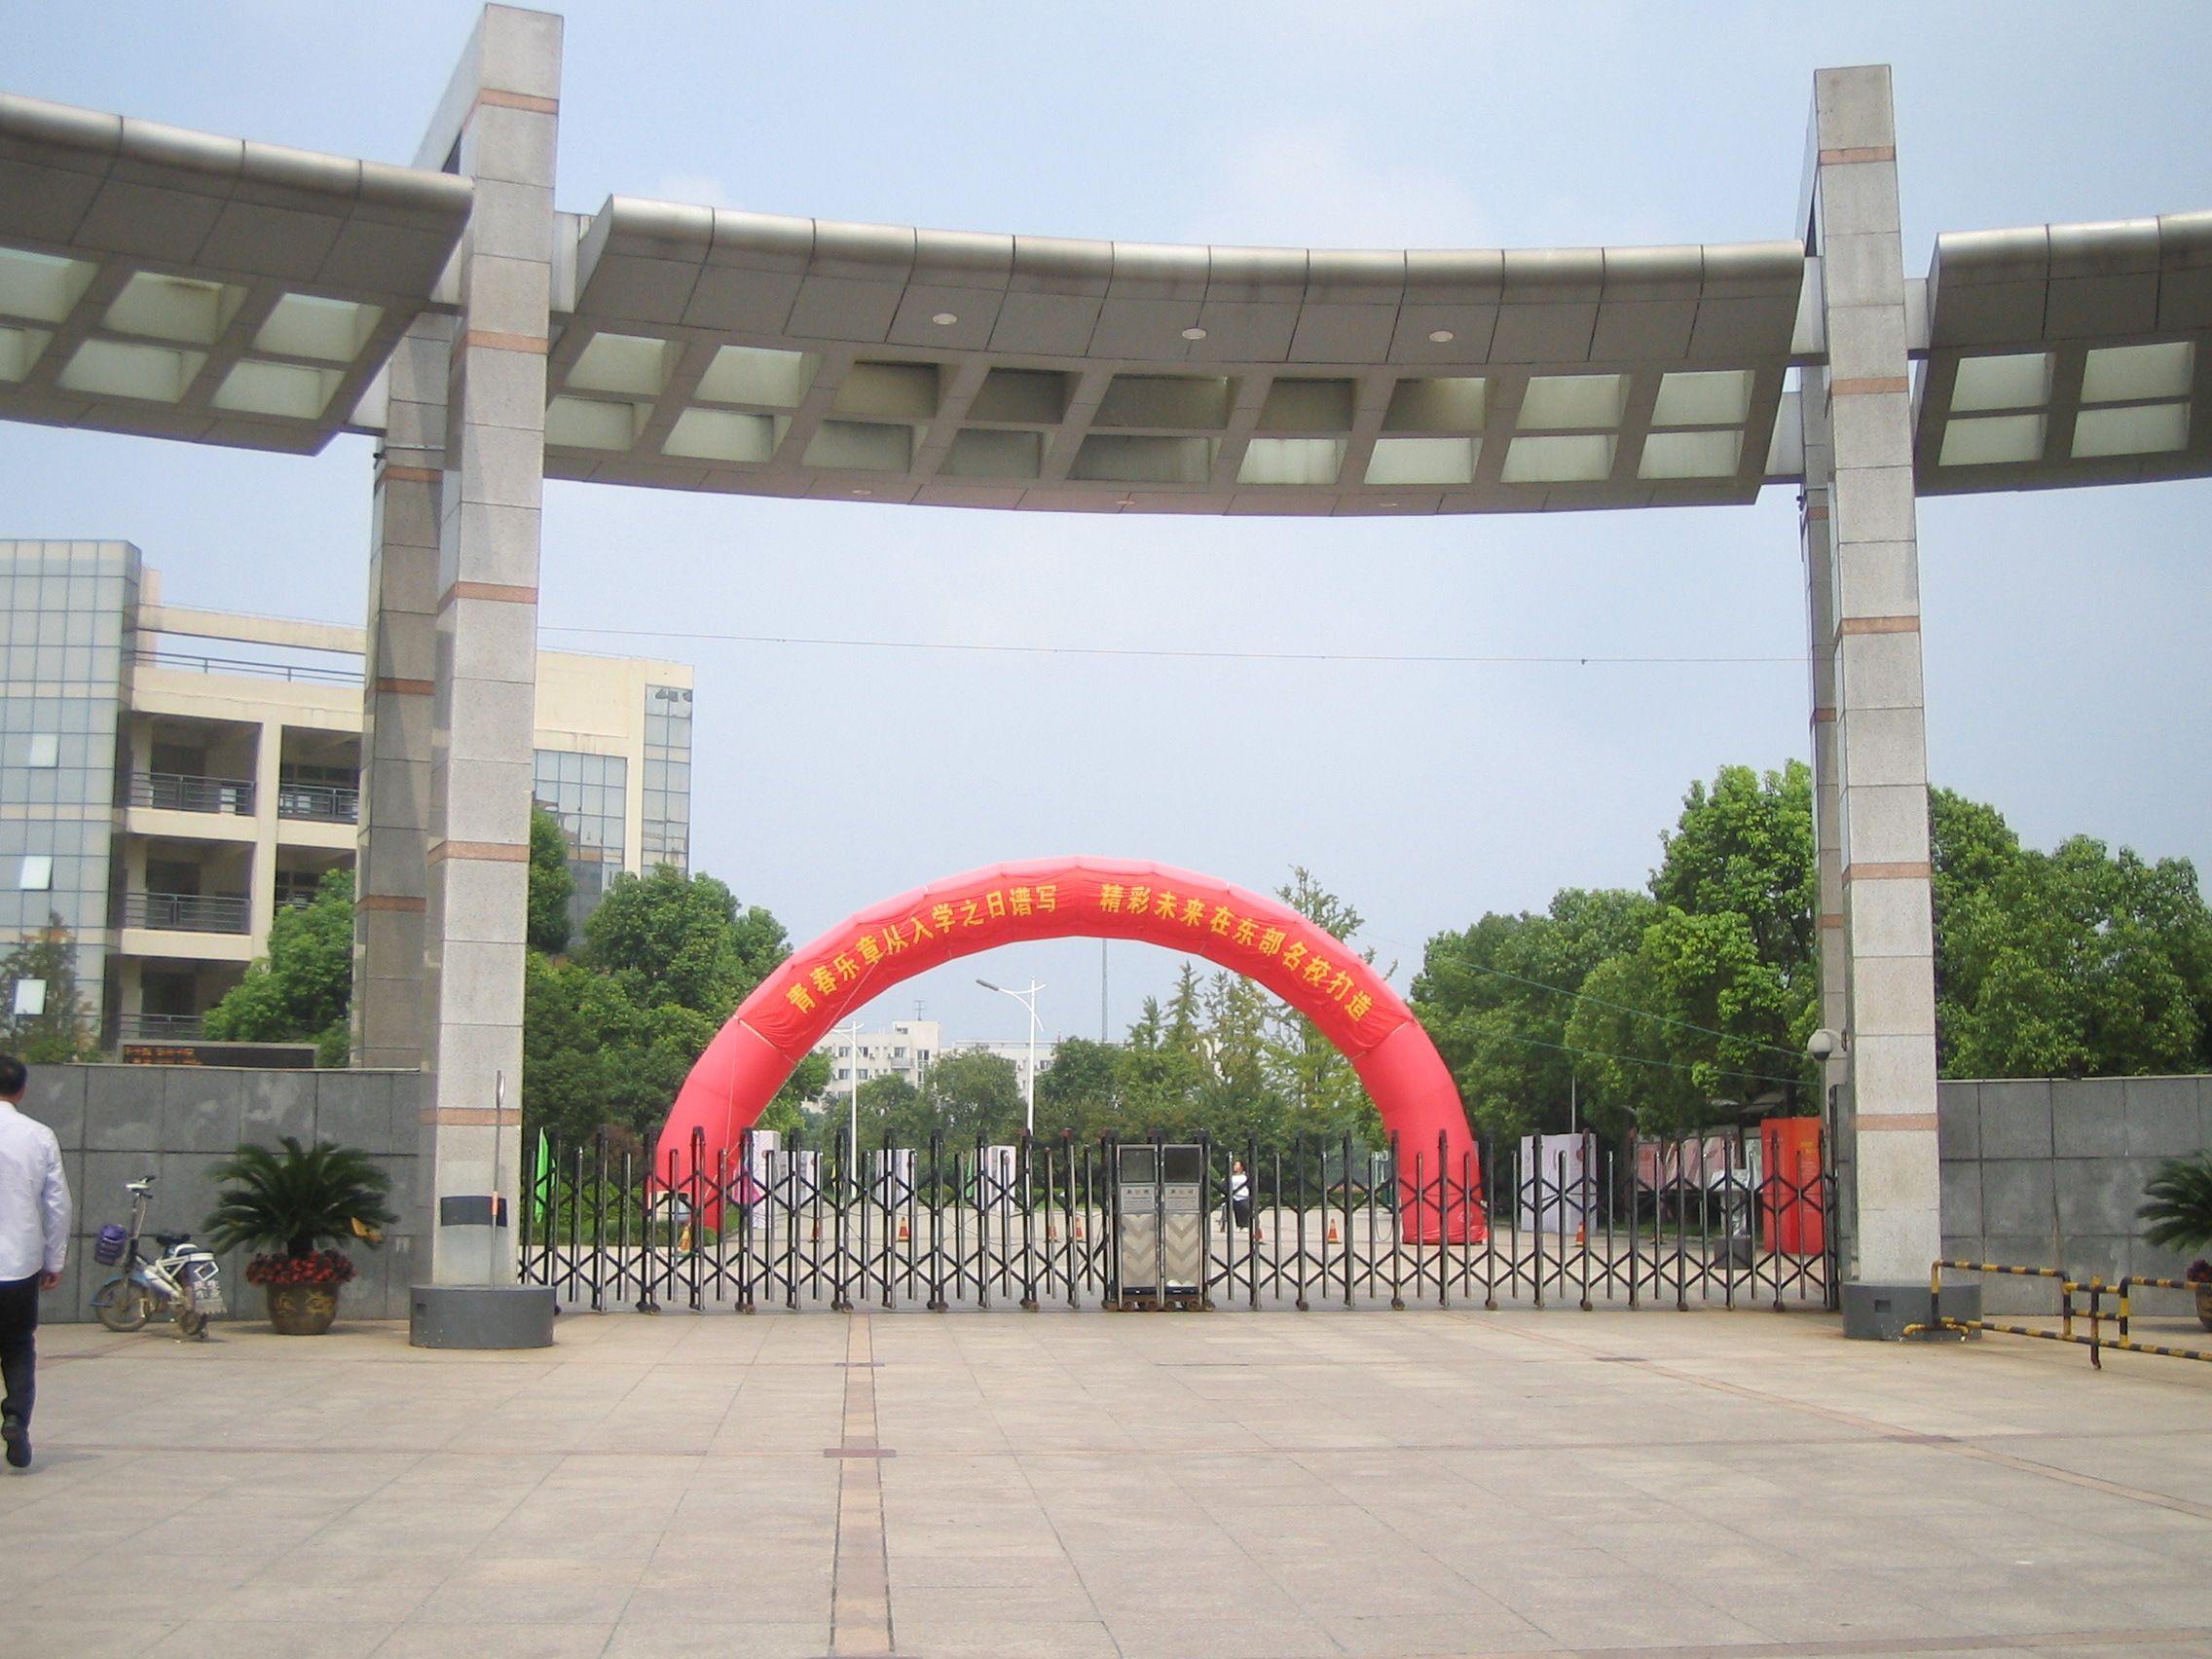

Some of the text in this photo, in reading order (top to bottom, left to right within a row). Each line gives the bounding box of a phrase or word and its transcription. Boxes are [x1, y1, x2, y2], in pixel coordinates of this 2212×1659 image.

[786, 883, 1373, 1021] 青春乐章从入学之日谱写 精彩未来在东部名校打造
